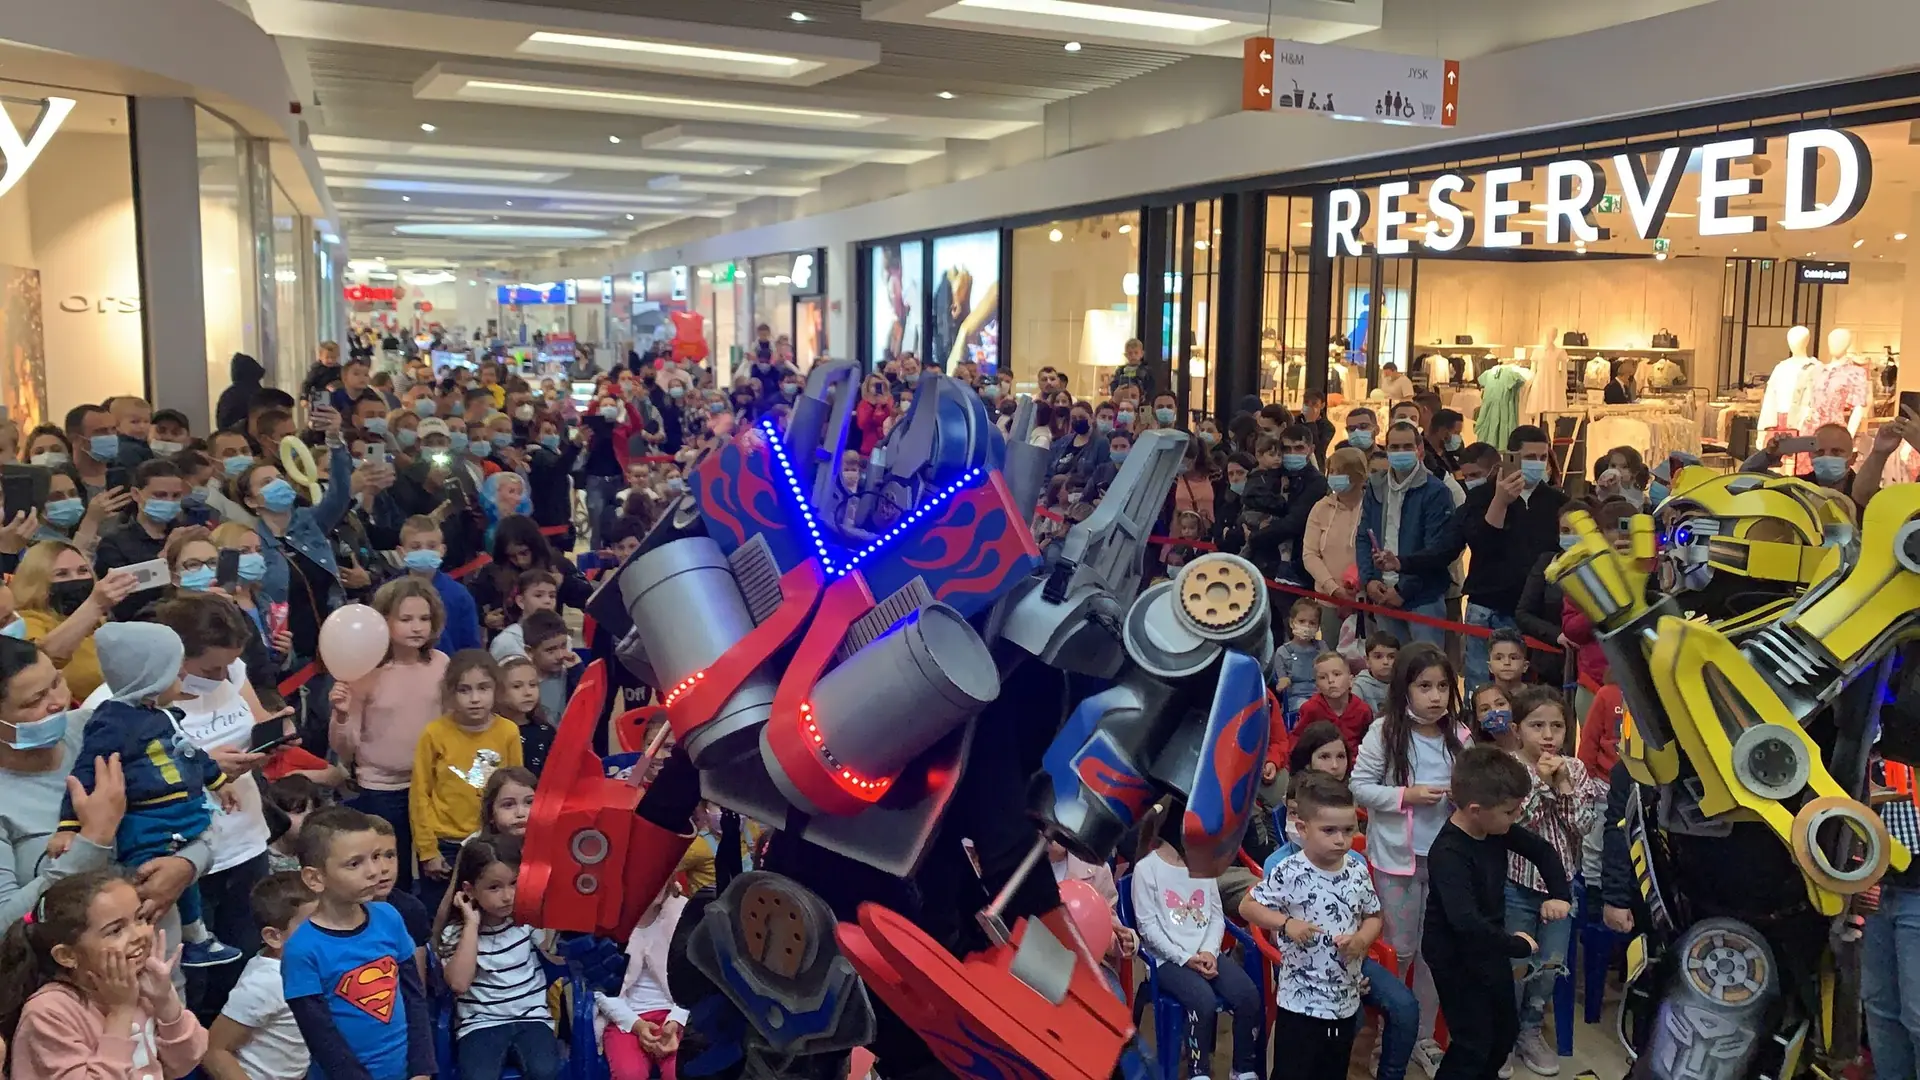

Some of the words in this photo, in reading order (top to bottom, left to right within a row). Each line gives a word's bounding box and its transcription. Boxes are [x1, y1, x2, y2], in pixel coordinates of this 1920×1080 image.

[1280, 52, 1304, 66] H&M
[1407, 67, 1428, 80] JYSK
[1327, 128, 1873, 258] RESERVED
